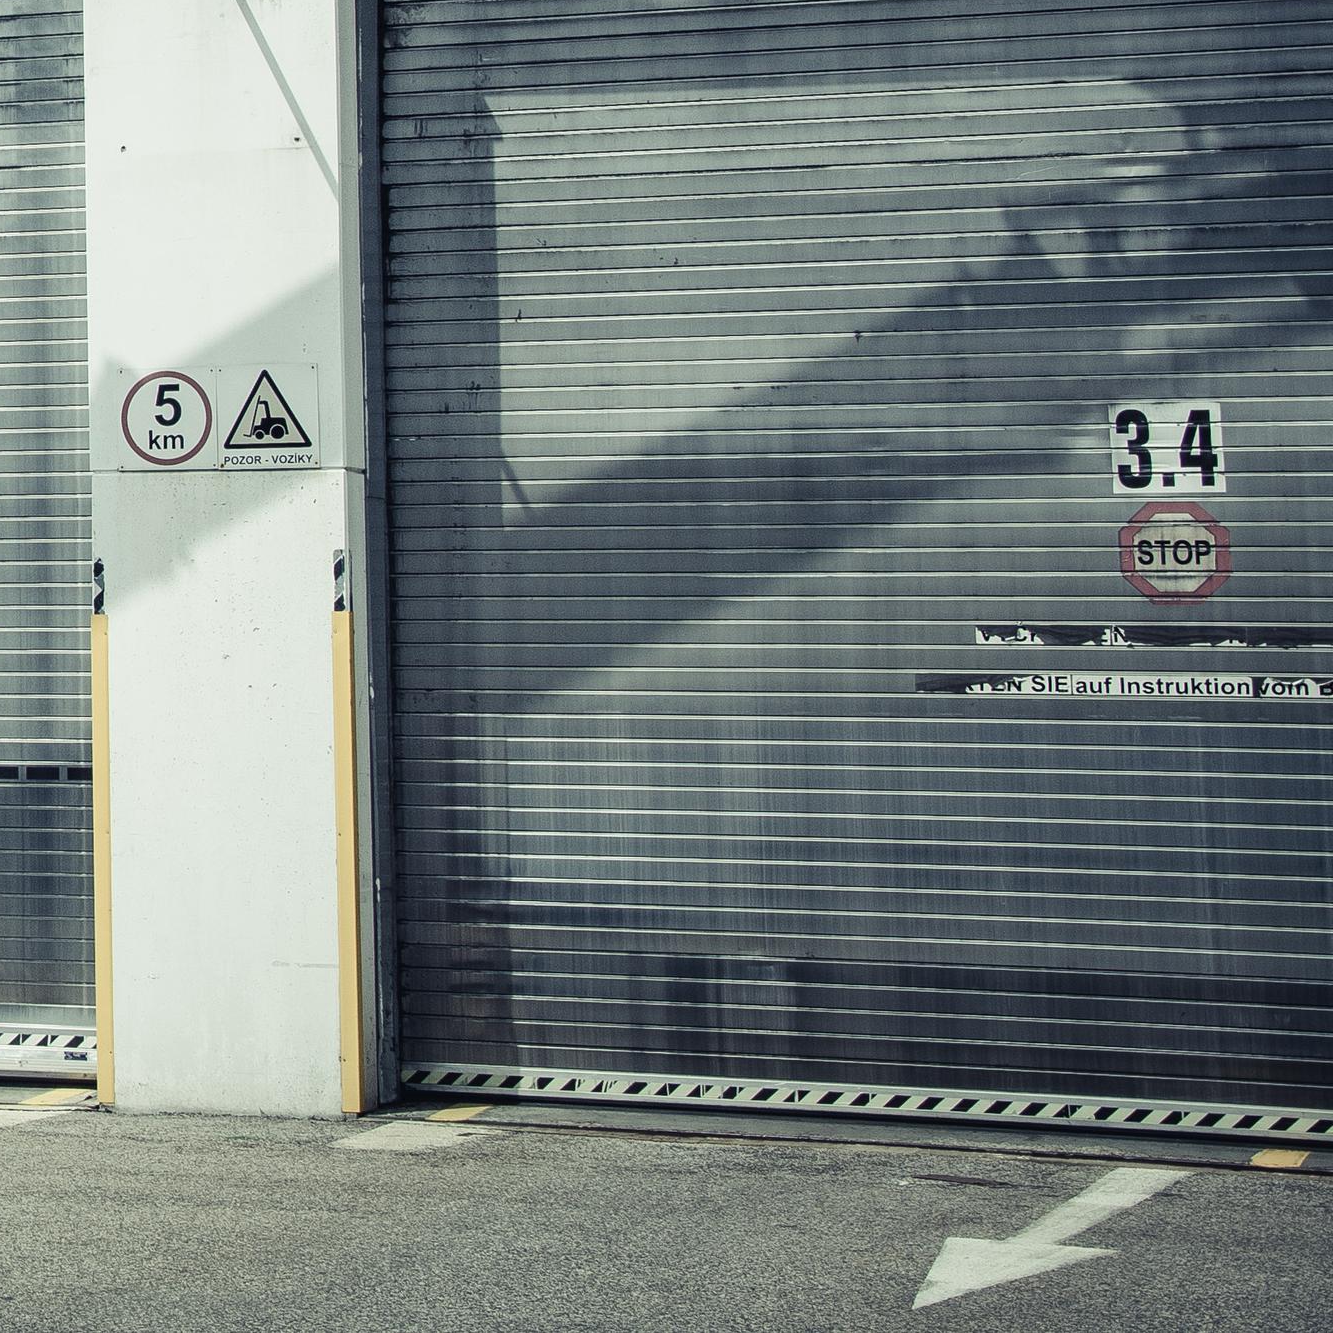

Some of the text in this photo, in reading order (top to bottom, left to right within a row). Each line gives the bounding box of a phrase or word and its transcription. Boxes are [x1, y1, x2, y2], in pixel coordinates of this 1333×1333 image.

[154, 383, 182, 427] 5
[148, 429, 185, 450] km
[1114, 409, 1219, 489] 3.4
[224, 455, 262, 465] POZOR
[271, 453, 313, 464] VOZÍKY
[1136, 539, 1212, 565] STOP
[1031, 675, 1069, 693] SIE
[1075, 676, 1112, 694] auf
[1120, 677, 1250, 696] Instruktion
